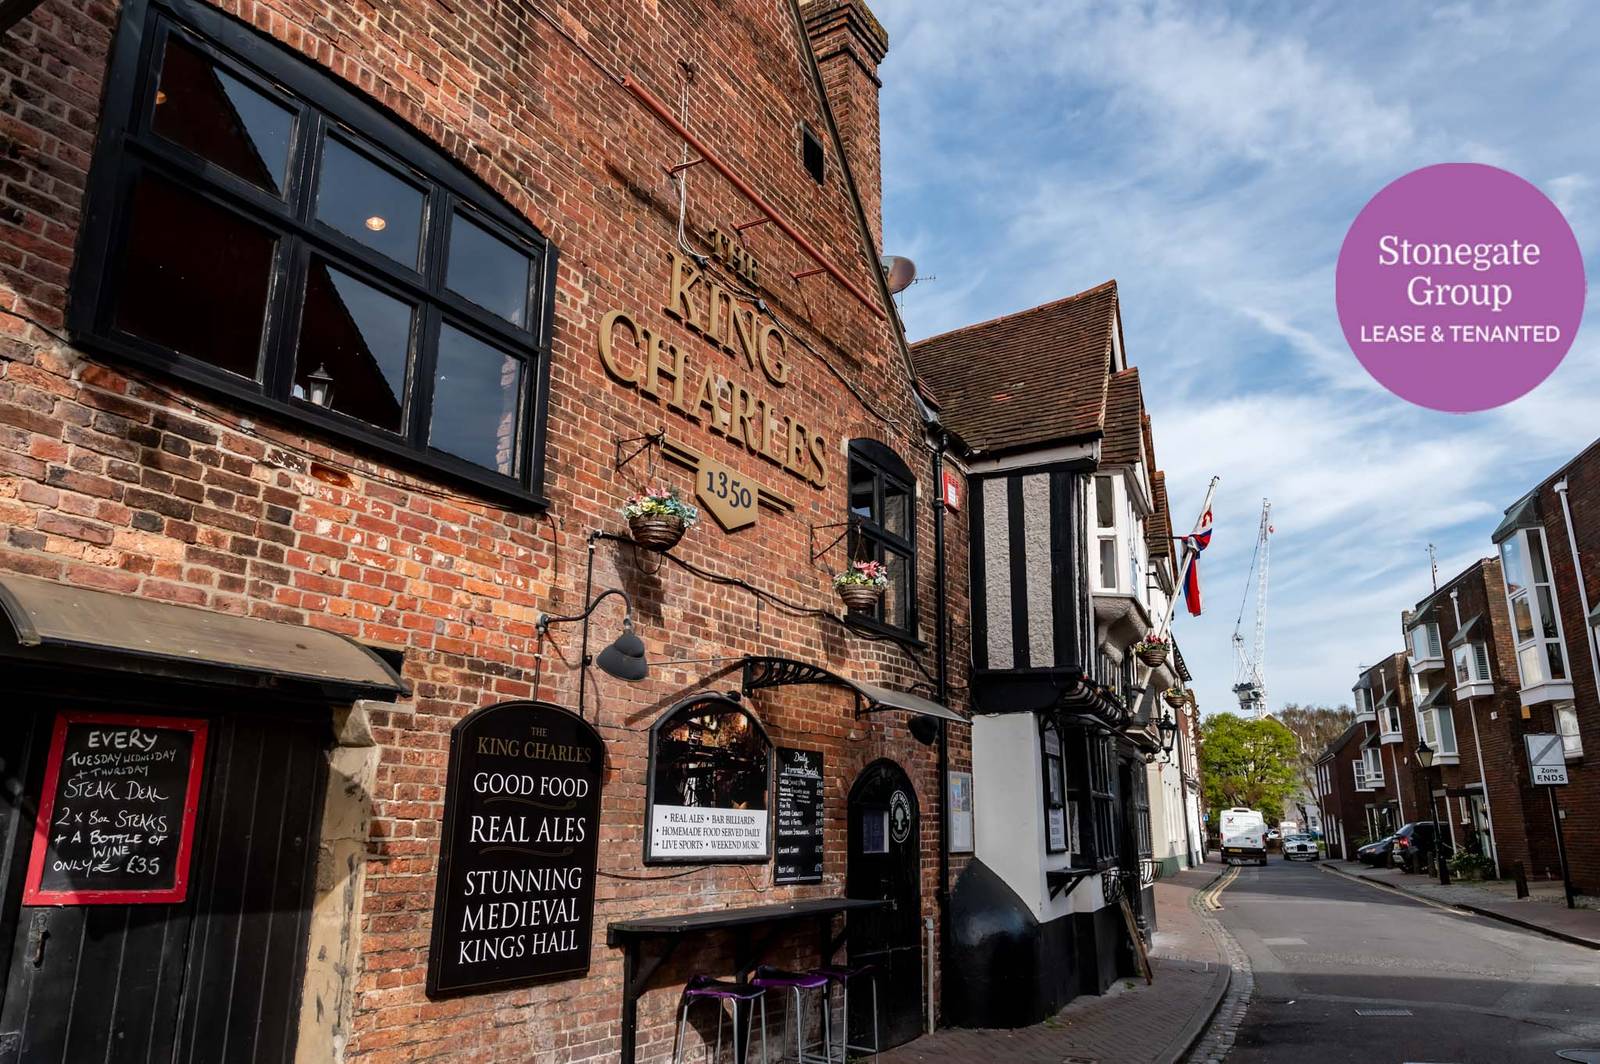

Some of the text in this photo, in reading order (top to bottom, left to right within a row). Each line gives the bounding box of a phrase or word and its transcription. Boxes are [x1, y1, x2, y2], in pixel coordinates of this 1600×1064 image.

[707, 226, 760, 288] THE
[664, 252, 790, 388] KING
[598, 310, 829, 490] CHARLES
[706, 471, 752, 508] 1350
[88, 729, 158, 751] EVERY
[530, 726, 548, 737] THE
[67, 749, 176, 766] TUESDAY WEDNESDAY
[477, 736, 592, 764] KING CHARLES
[90, 765, 149, 777] THURSDAY
[64, 778, 120, 801] STEAK
[473, 772, 589, 798] GOOD FOOD
[55, 806, 70, 826] 2
[670, 813, 755, 825] REAL ALES BAR BILLIARDS
[71, 830, 81, 843] A
[148, 835, 168, 846] OF
[470, 815, 586, 843] REAL ALES
[662, 826, 761, 837] HOMEMADE FOOD SERVED DAILY
[92, 845, 131, 860] WINE
[661, 840, 760, 850] LIVE SPORTS WEEKEND MUSIC
[53, 859, 93, 878] ONLY
[126, 855, 160, 875] £35
[464, 867, 582, 896] STUNNING
[460, 897, 580, 933] MEDIEVAL
[458, 929, 579, 965] KINGS HALL
